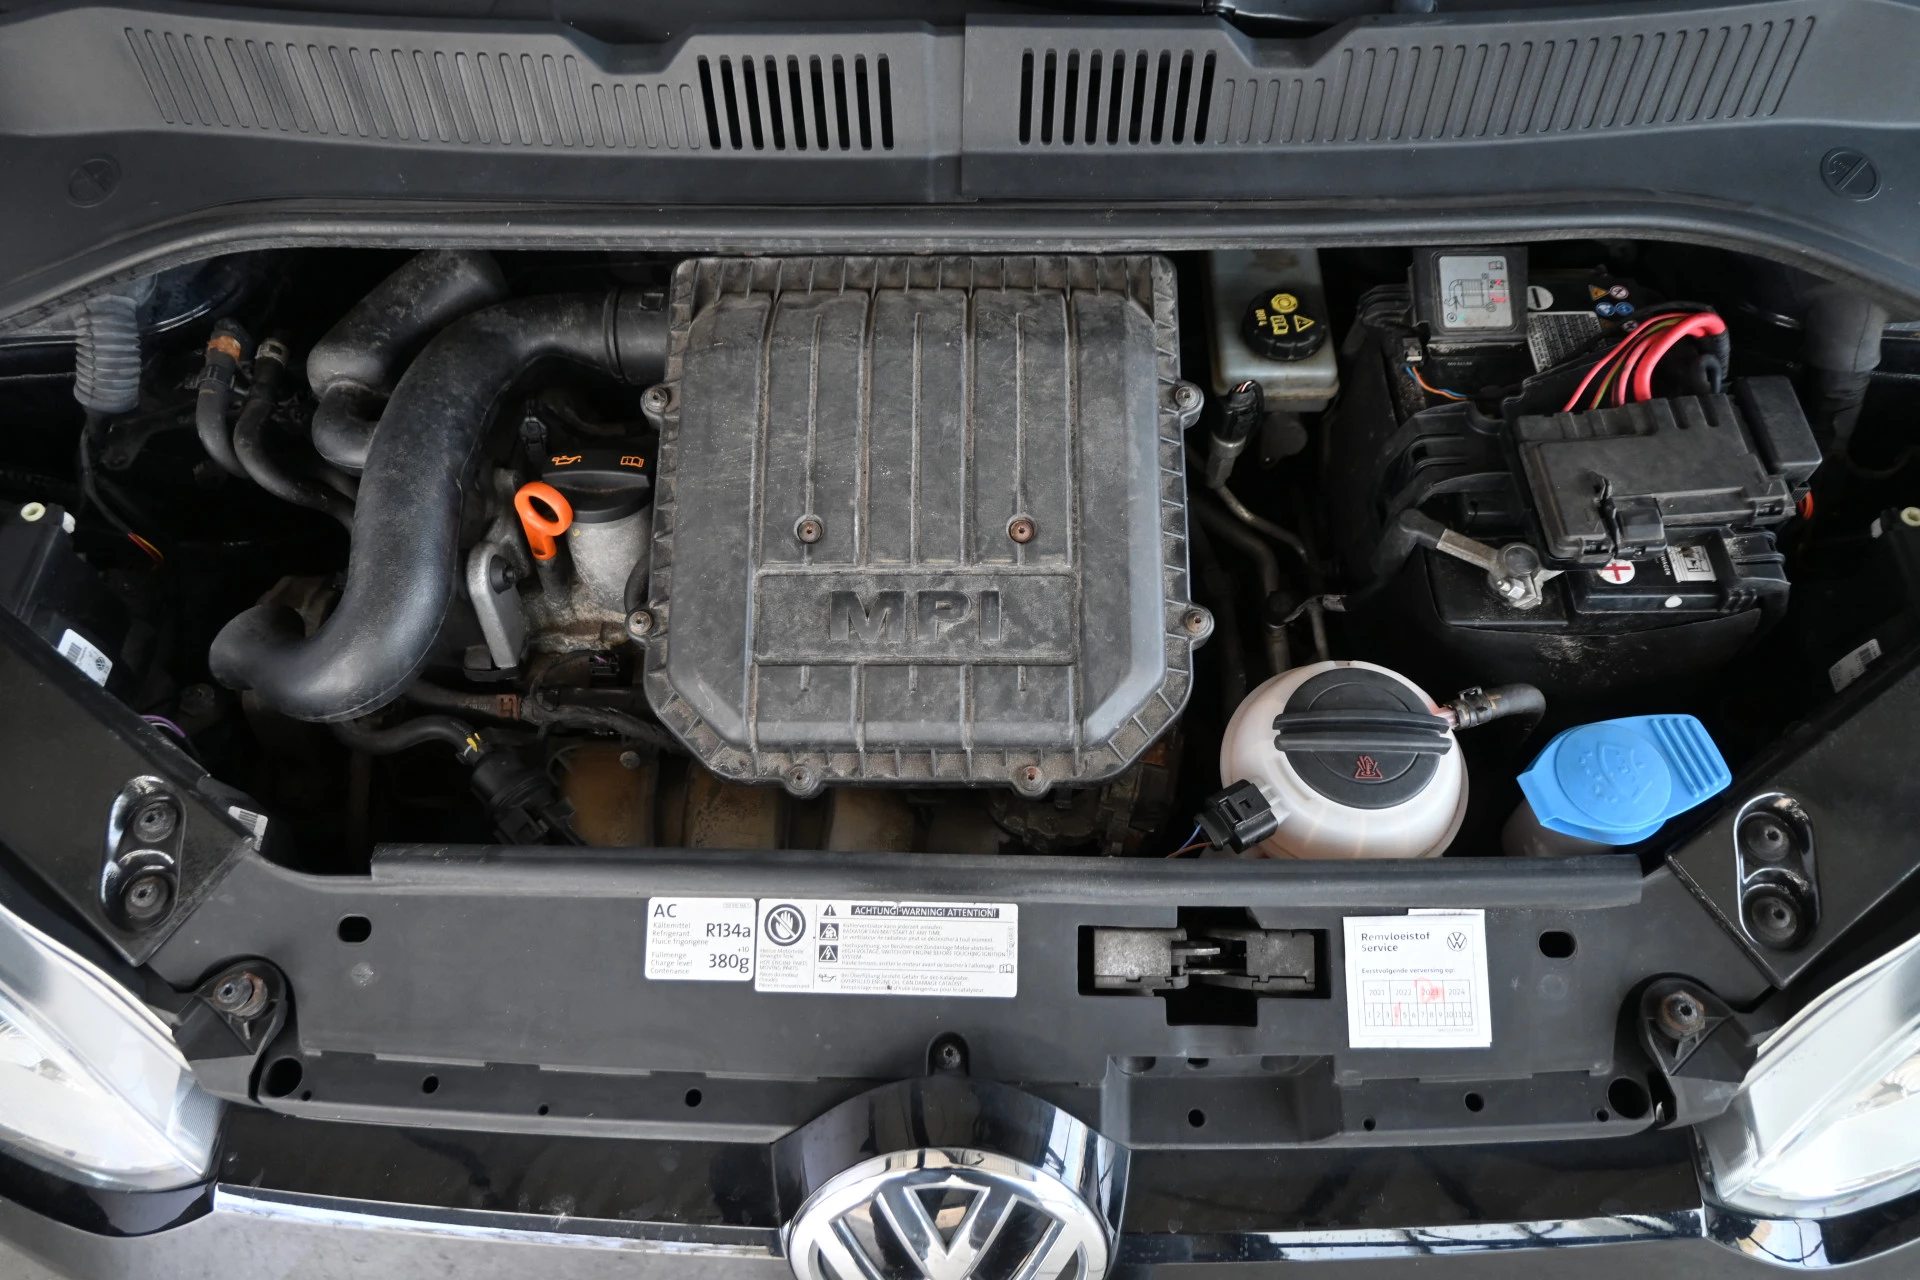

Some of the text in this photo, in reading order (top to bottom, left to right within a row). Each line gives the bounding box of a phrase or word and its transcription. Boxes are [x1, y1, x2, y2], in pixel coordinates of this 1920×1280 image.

[829, 590, 1001, 641] MPI
[653, 903, 677, 918] AC
[854, 906, 996, 918] ACHTUNG! WARNING! ATTENTION!
[652, 930, 690, 938] Refrigerant
[706, 922, 751, 938] R134a
[1361, 931, 1430, 941] Remvloeistof
[1361, 943, 1398, 952] Service
[1447, 932, 1468, 952] VW
[650, 960, 675, 968] Charge
[708, 953, 750, 974] 380g
